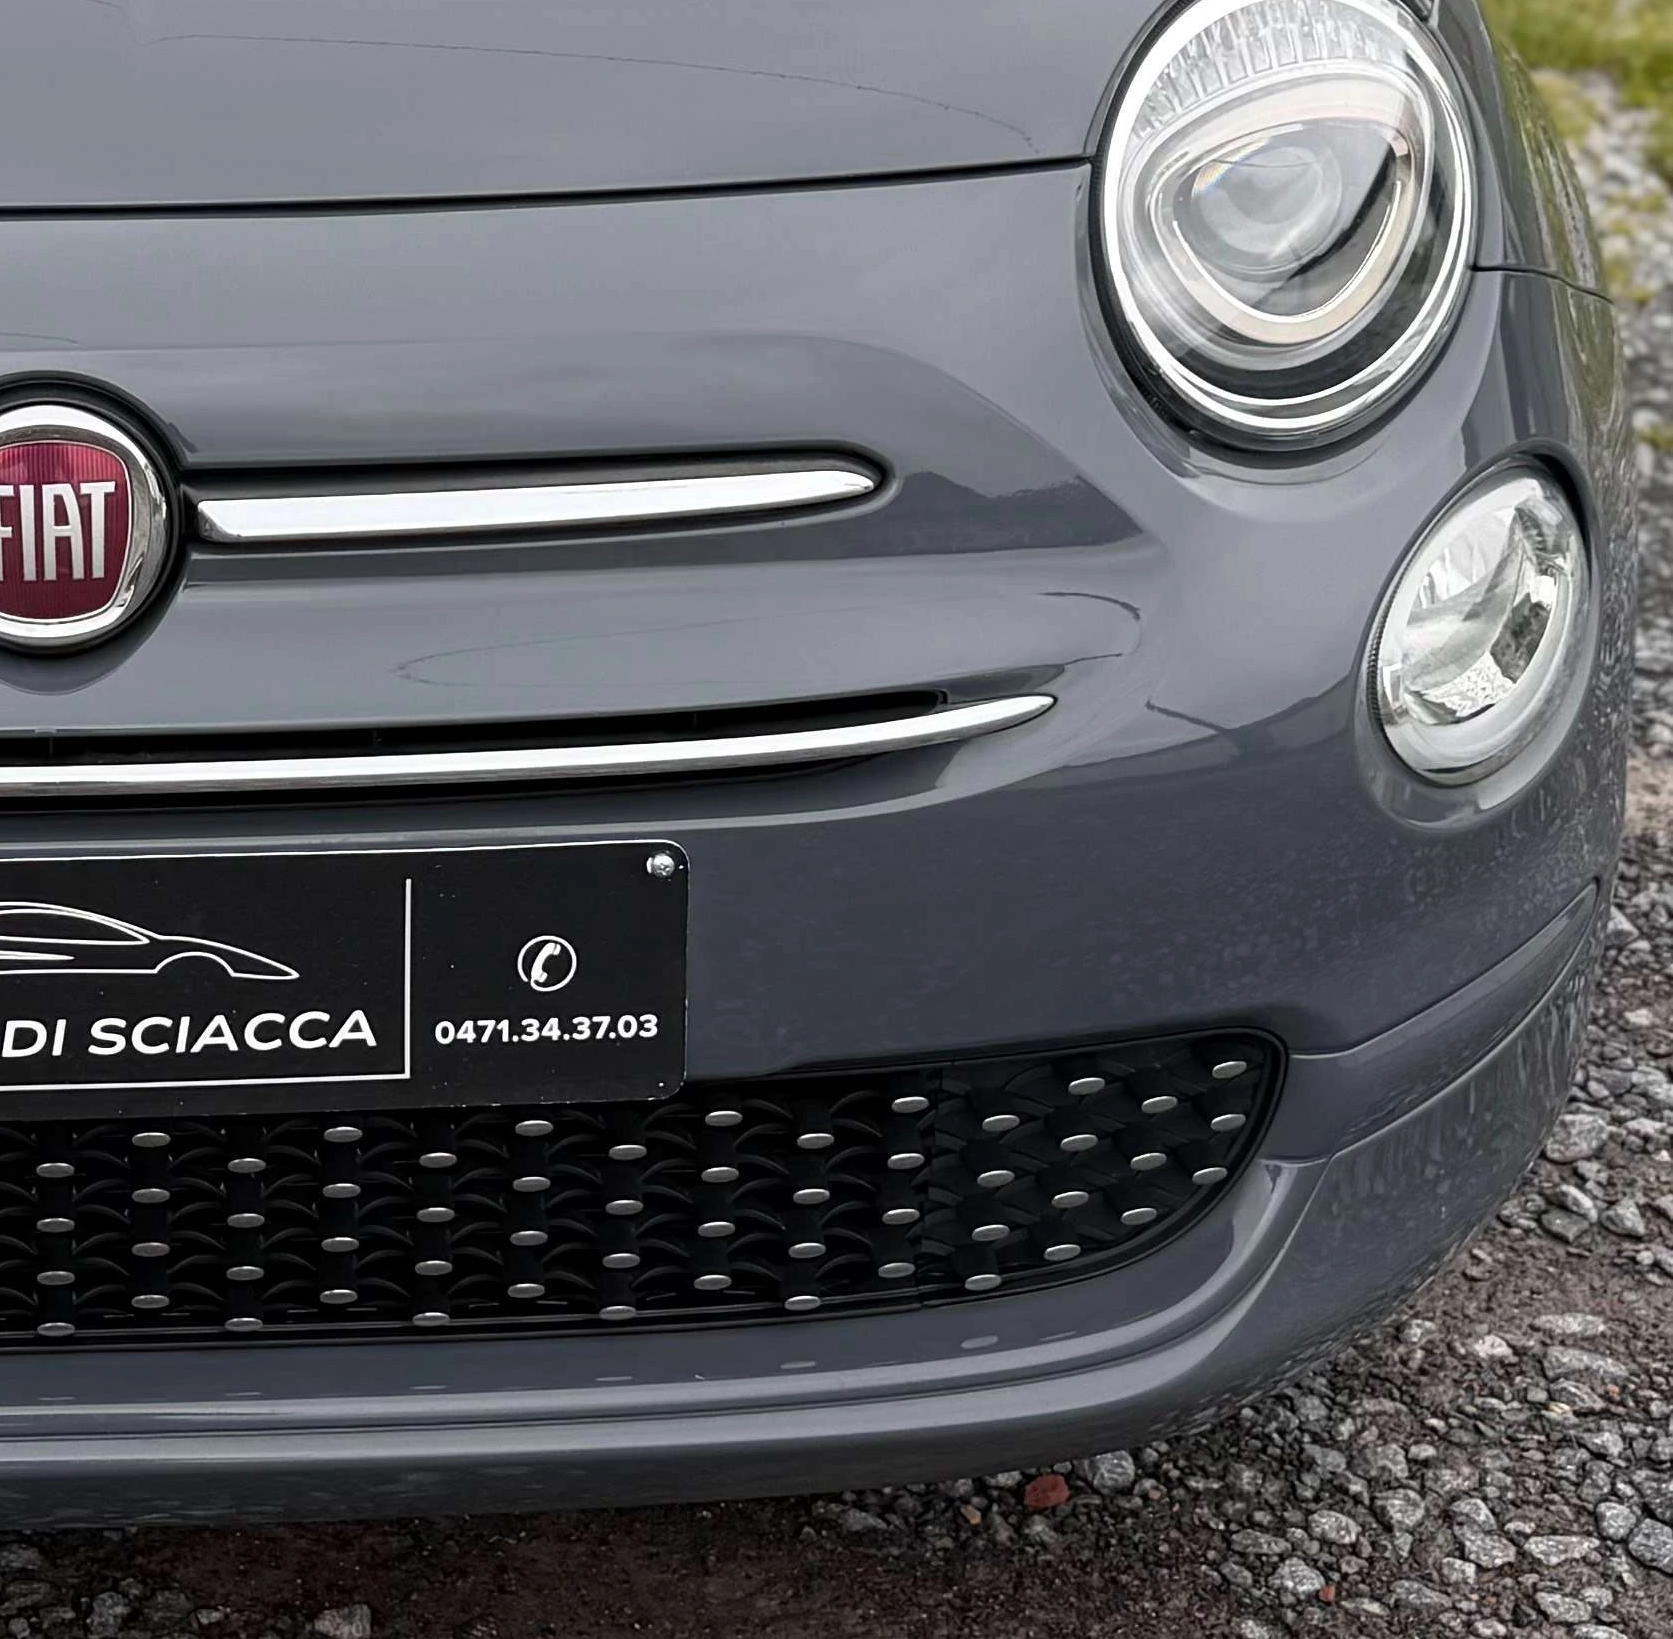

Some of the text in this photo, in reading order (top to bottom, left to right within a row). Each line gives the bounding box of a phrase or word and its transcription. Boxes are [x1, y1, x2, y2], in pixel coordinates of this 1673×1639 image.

[1, 1019, 67, 1058] DI
[87, 1010, 377, 1055] SCIACCA
[435, 1014, 658, 1045] 0471.34.37.03
